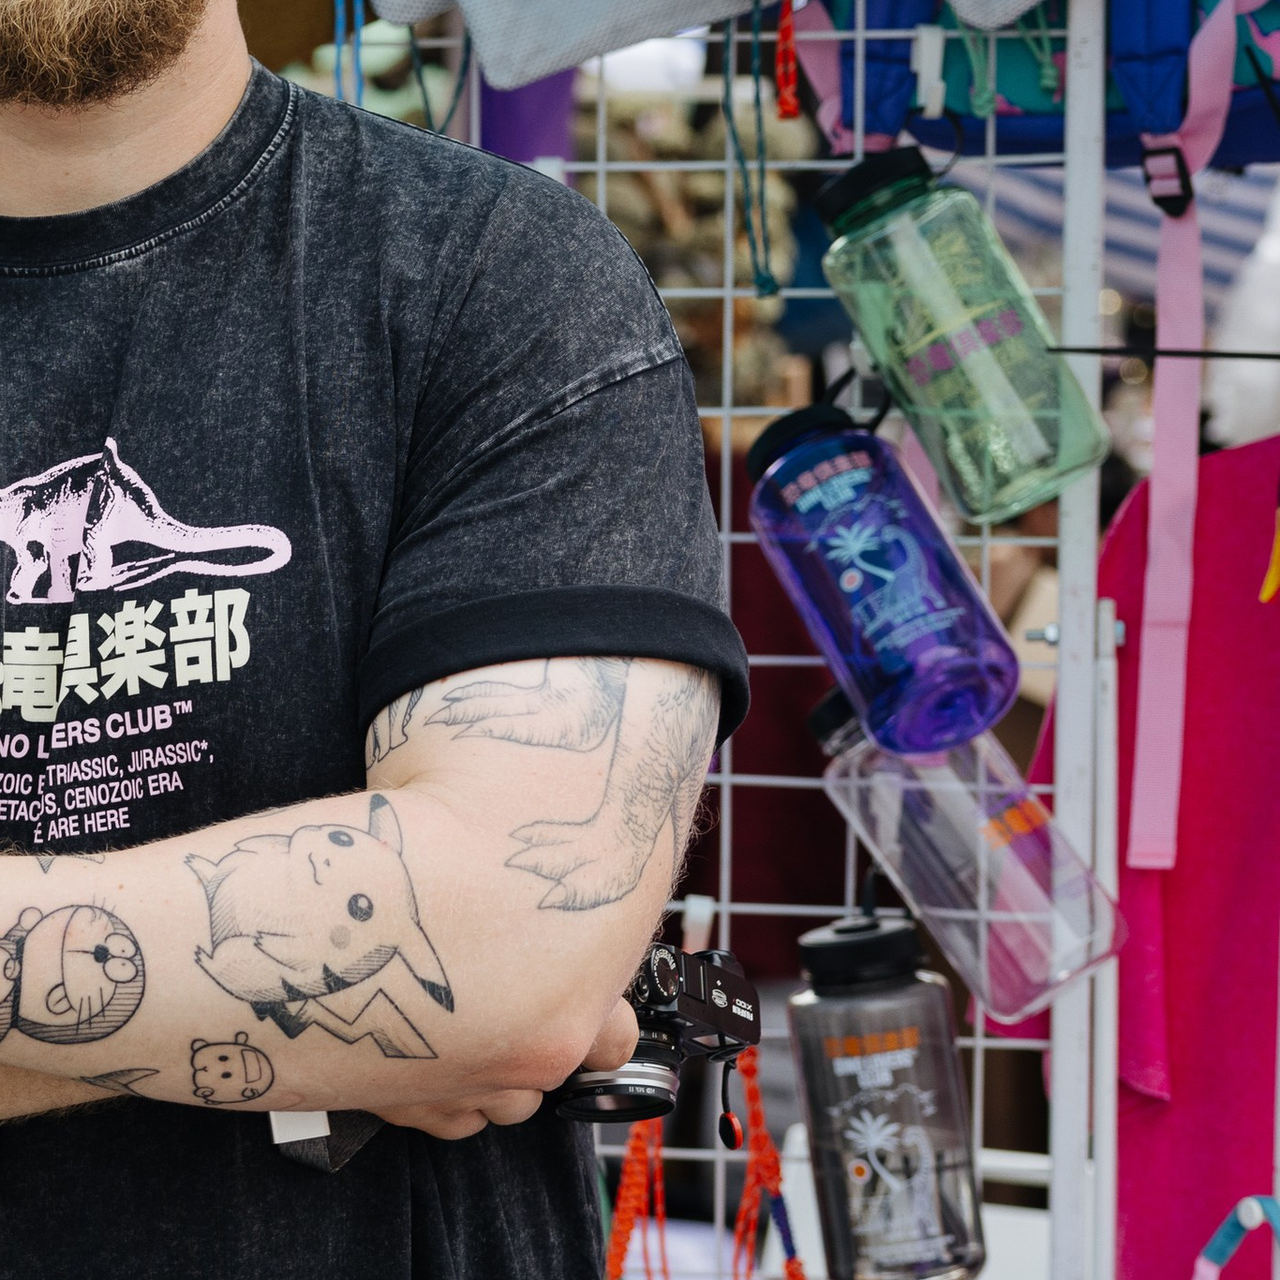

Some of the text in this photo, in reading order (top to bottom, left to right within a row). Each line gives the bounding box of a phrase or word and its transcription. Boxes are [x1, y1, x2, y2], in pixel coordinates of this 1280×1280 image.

[46, 754, 124, 786] TRIASSIC,
[64, 777, 144, 811] CENOZOIC
[147, 770, 184, 796] ERA
[47, 814, 80, 842] ARE
[84, 806, 131, 834] HERE
